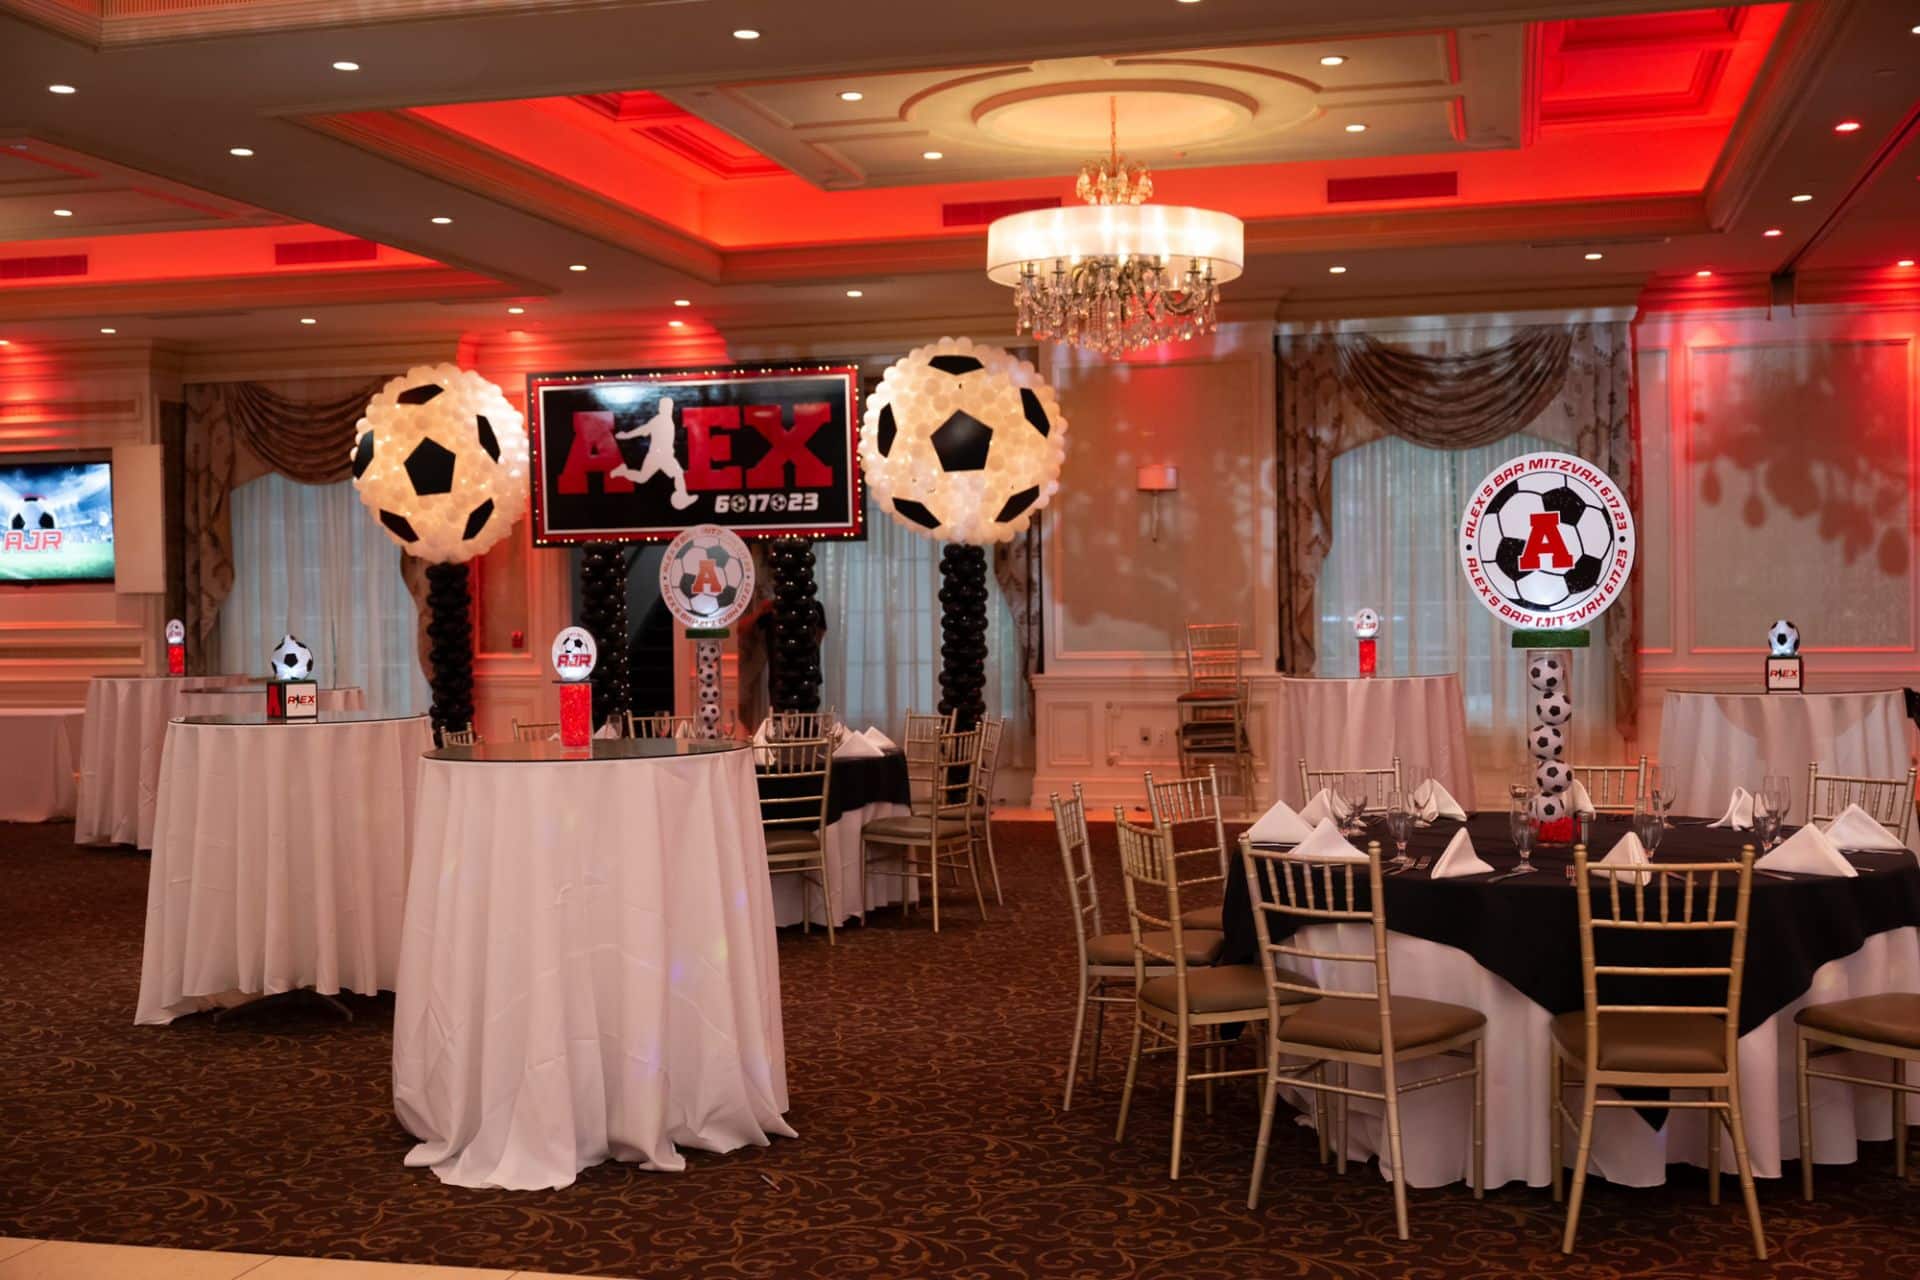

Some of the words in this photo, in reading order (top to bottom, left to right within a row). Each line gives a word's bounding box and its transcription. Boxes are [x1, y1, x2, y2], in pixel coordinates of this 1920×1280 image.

[1465, 486, 1494, 539] ALEX'S
[1493, 463, 1525, 485] BAR
[1528, 458, 1603, 488] MITZVAH
[1600, 487, 1628, 531] 6.17.23
[4, 529, 63, 551] AJR
[1519, 512, 1574, 571] A
[692, 559, 722, 593] A
[1467, 557, 1502, 608] ALEX'S
[1604, 549, 1628, 594] 6.17.23
[557, 653, 593, 668] AJR
